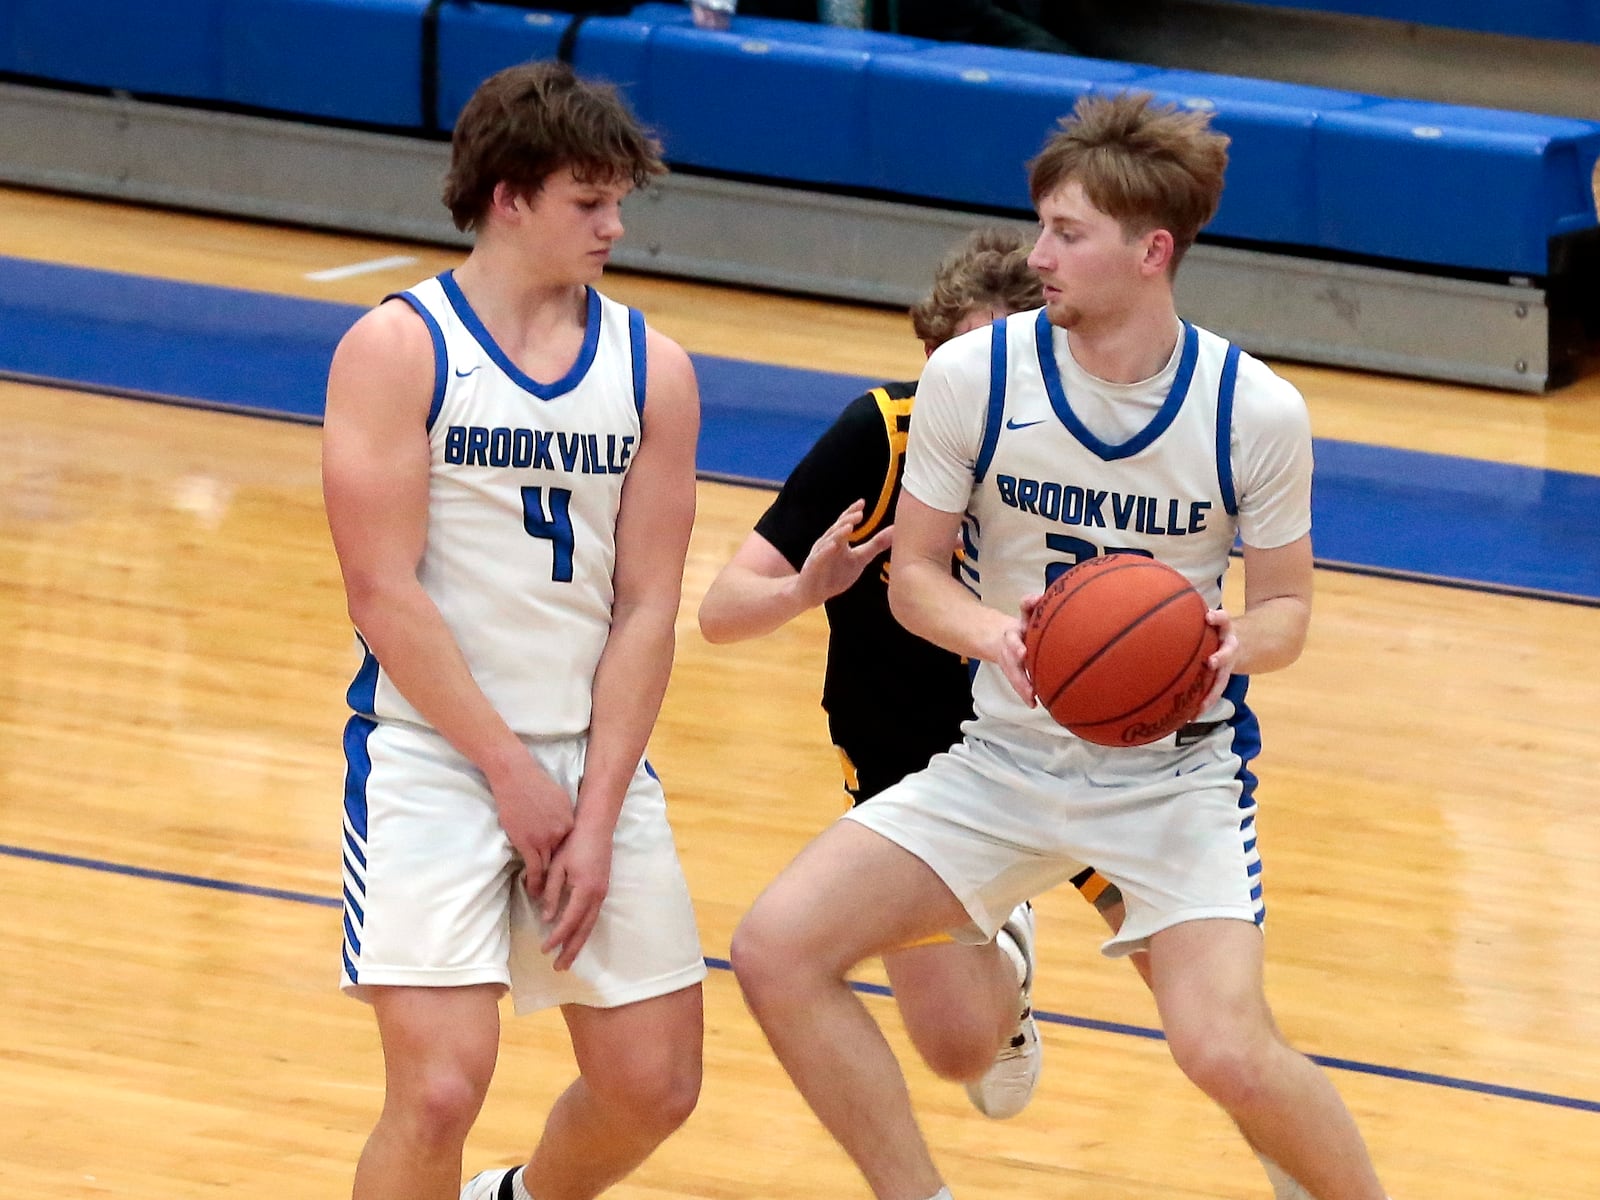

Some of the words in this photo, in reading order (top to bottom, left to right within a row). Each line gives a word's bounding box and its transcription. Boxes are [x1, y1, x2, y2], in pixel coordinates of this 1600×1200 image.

[444, 426, 635, 475] BROOKVILLE
[520, 485, 575, 583] 4
[996, 474, 1212, 536] BROOKVILLE
[1044, 532, 1154, 598] 2
